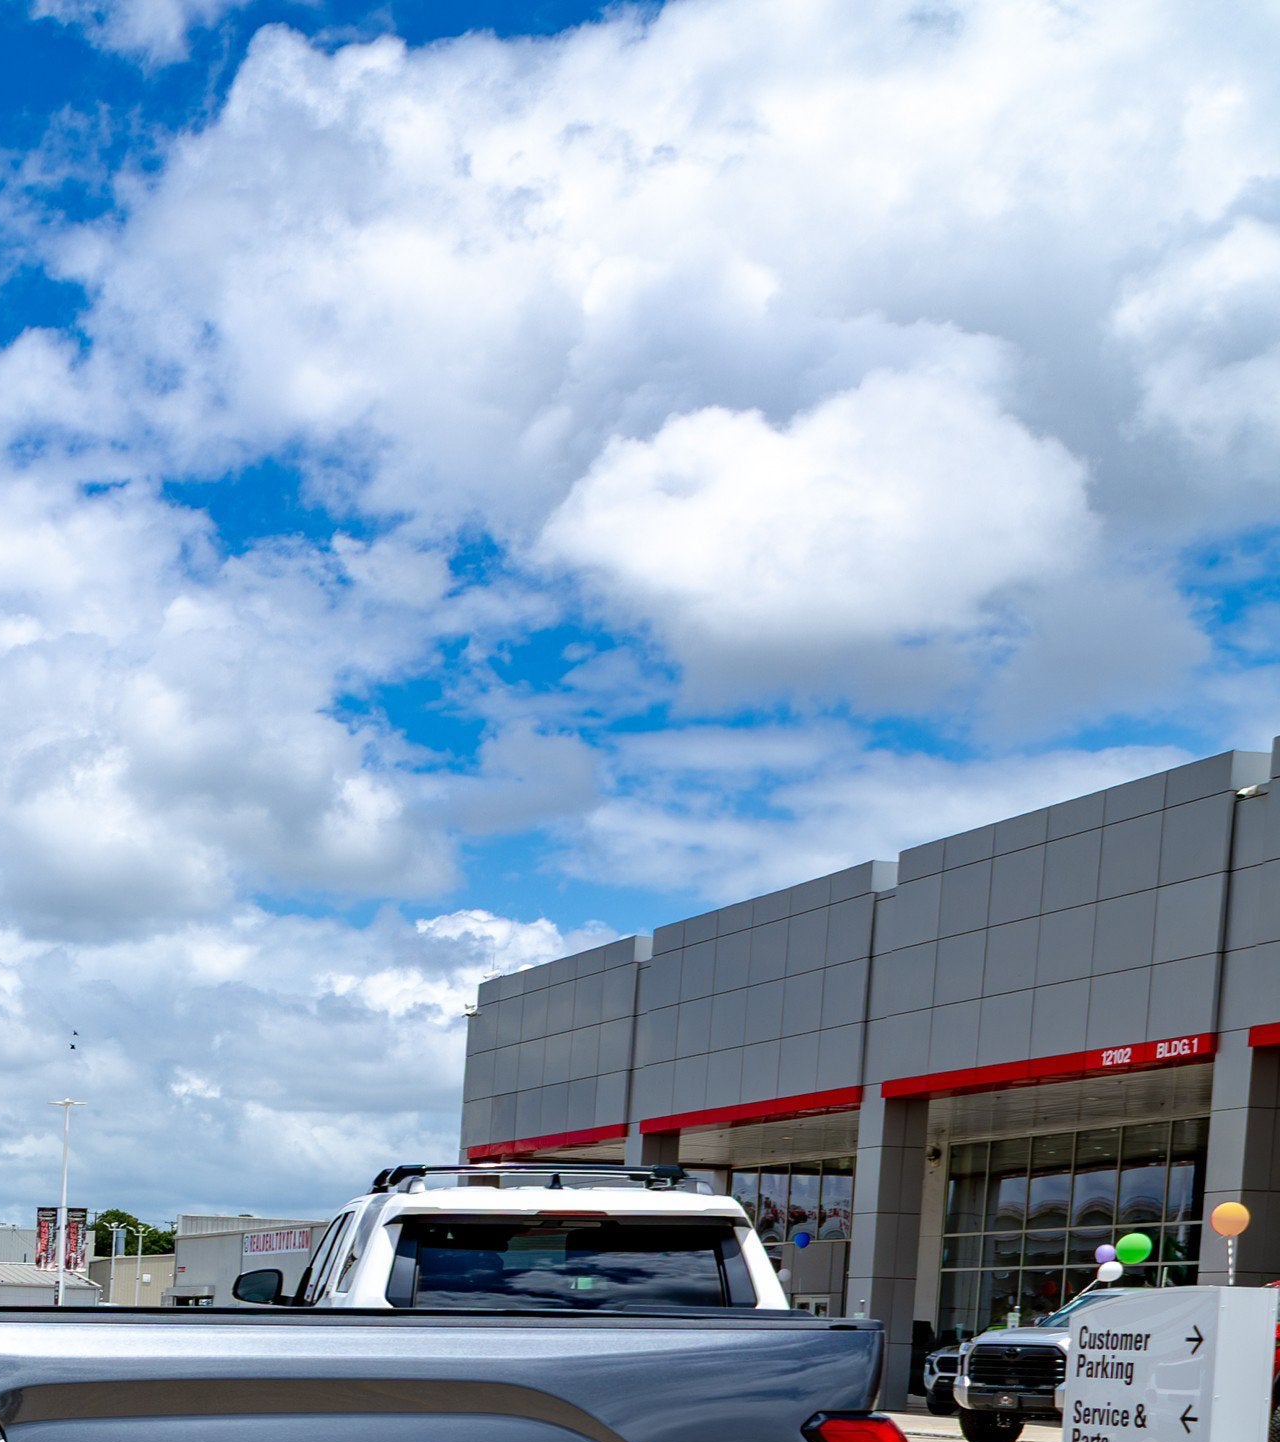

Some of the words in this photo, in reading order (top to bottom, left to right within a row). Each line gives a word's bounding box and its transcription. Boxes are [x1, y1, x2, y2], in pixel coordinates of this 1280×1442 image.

[1101, 1048, 1132, 1066] 12102
[1078, 1325, 1151, 1352] Customer
[1076, 1354, 1134, 1386] Parking
[1072, 1400, 1130, 1427] Service
[1134, 1403, 1148, 1429] &
